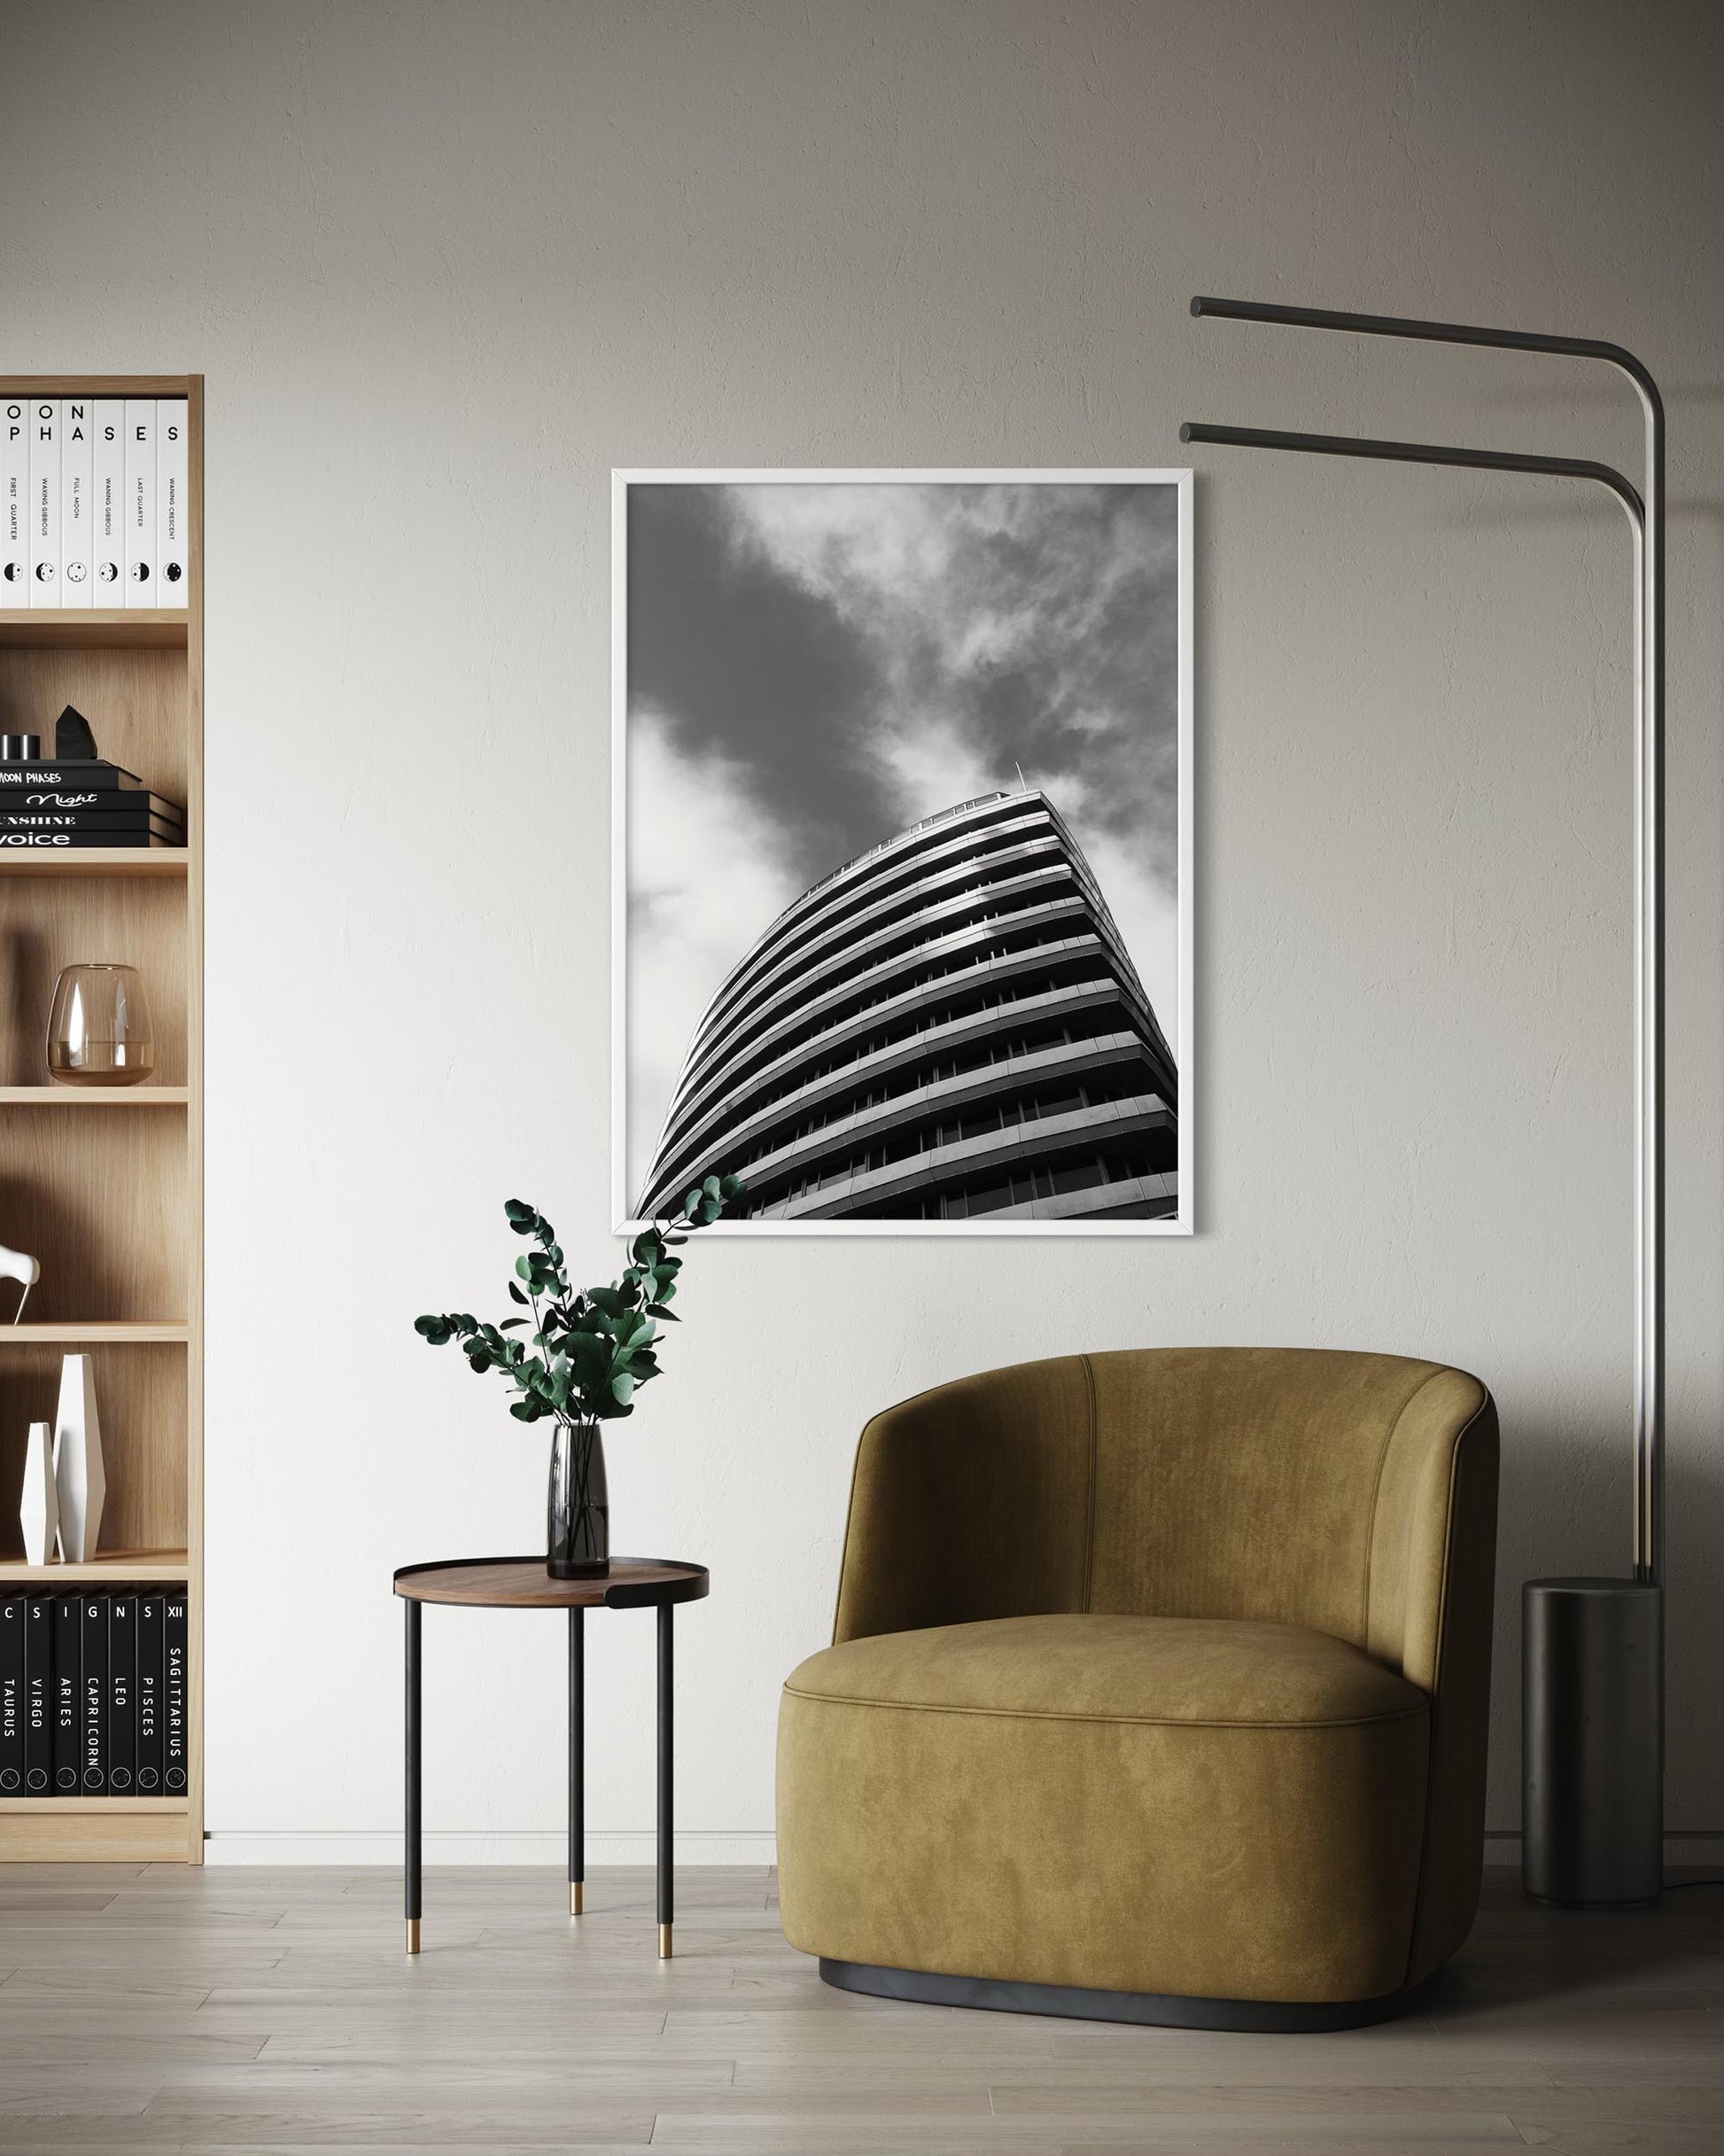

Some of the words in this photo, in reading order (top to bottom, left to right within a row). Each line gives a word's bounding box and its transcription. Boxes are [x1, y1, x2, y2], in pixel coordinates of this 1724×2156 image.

[26, 772, 62, 784] PHASES
[26, 793, 97, 807] Night
[167, 1606, 182, 1618] XII
[4, 1678, 15, 1737] TAURUS
[31, 1678, 43, 1728] VIRGO
[60, 1677, 72, 1726] ARIES
[115, 1677, 127, 1706] LEO
[143, 1677, 154, 1736] PISCES
[169, 1647, 182, 1756] SAGITTARIUS
[88, 1677, 99, 1766] CAPRICORN
